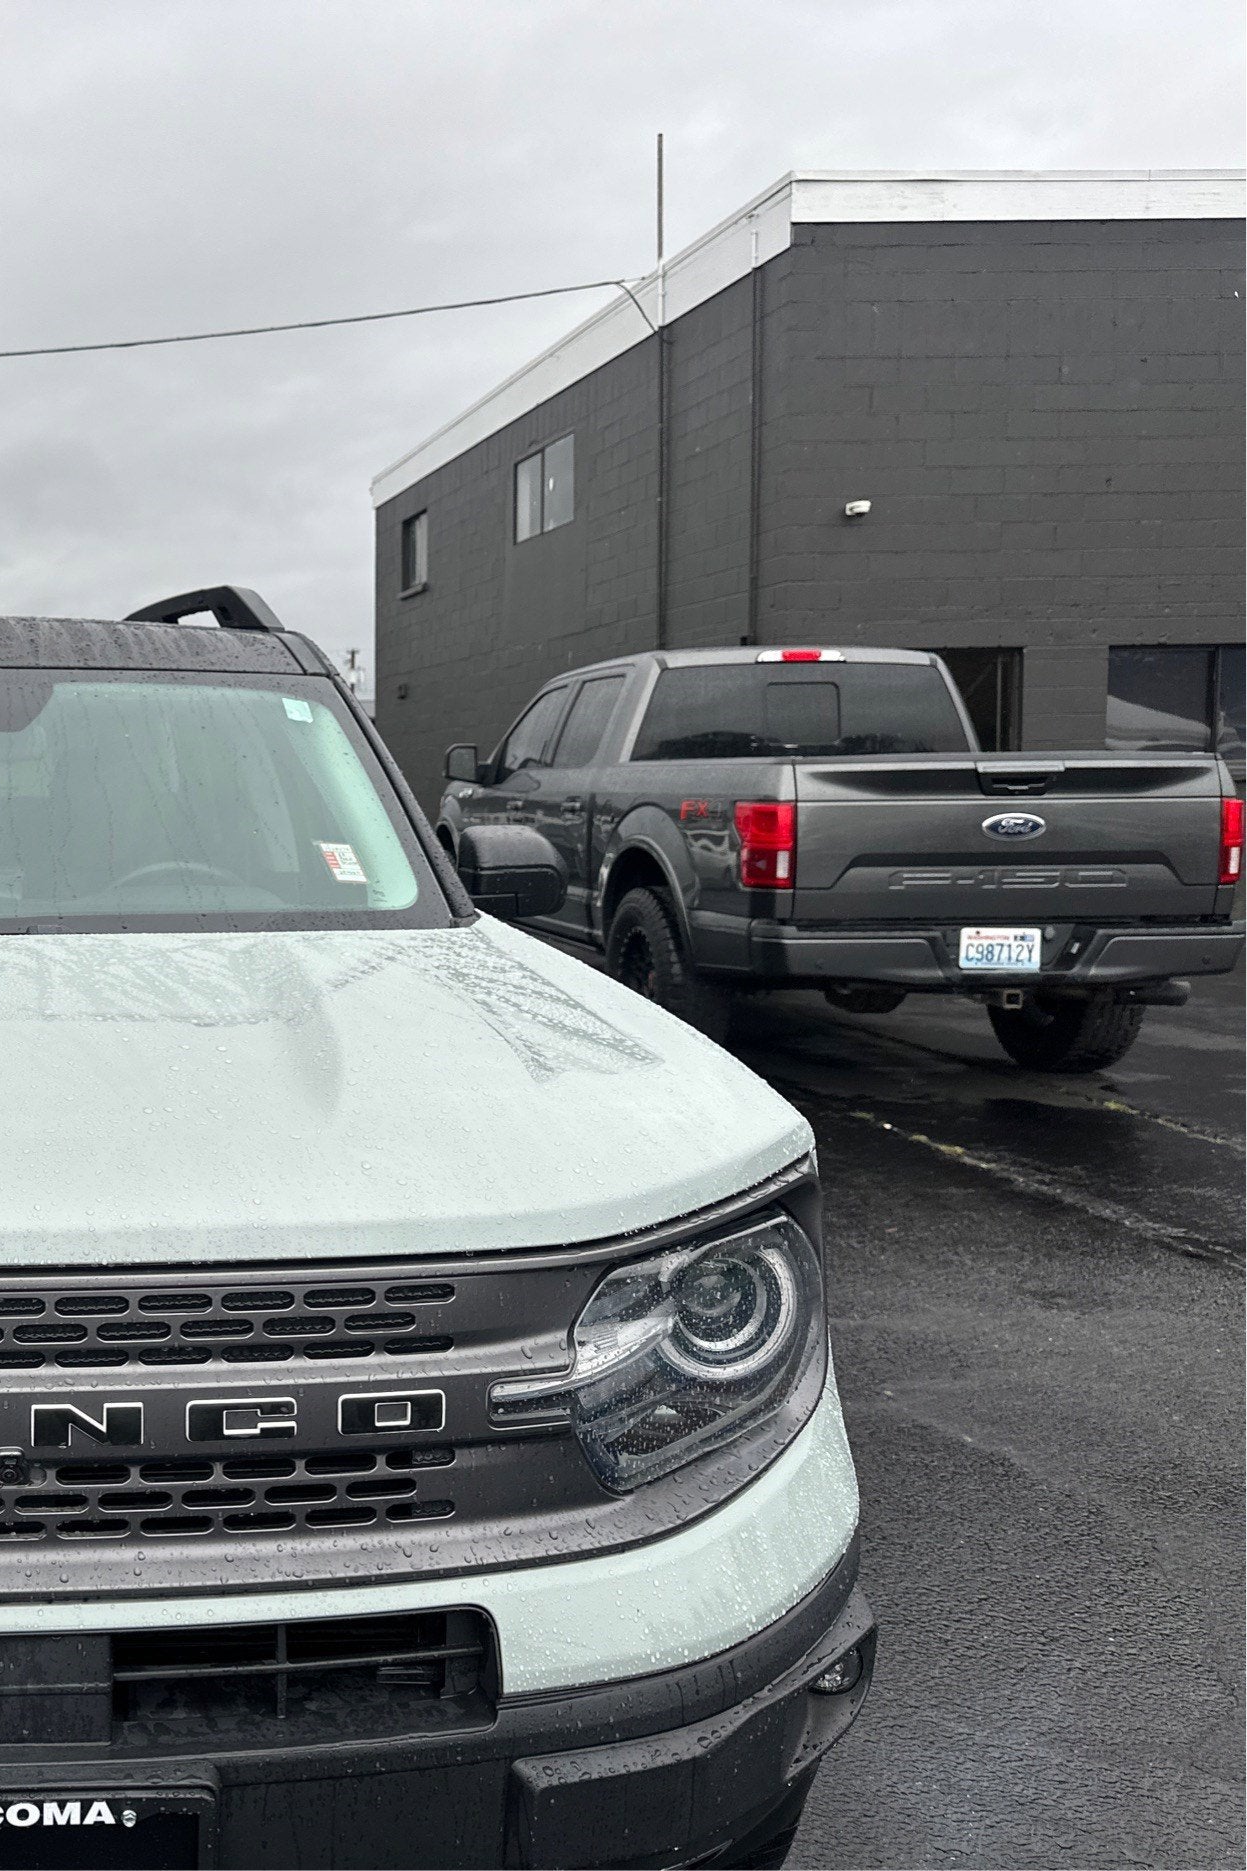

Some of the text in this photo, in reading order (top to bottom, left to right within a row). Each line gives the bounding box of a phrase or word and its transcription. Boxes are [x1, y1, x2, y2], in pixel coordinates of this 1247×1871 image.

[679, 799, 726, 821] FX4
[888, 868, 1128, 890] F-150
[964, 942, 1035, 963] C98712Y
